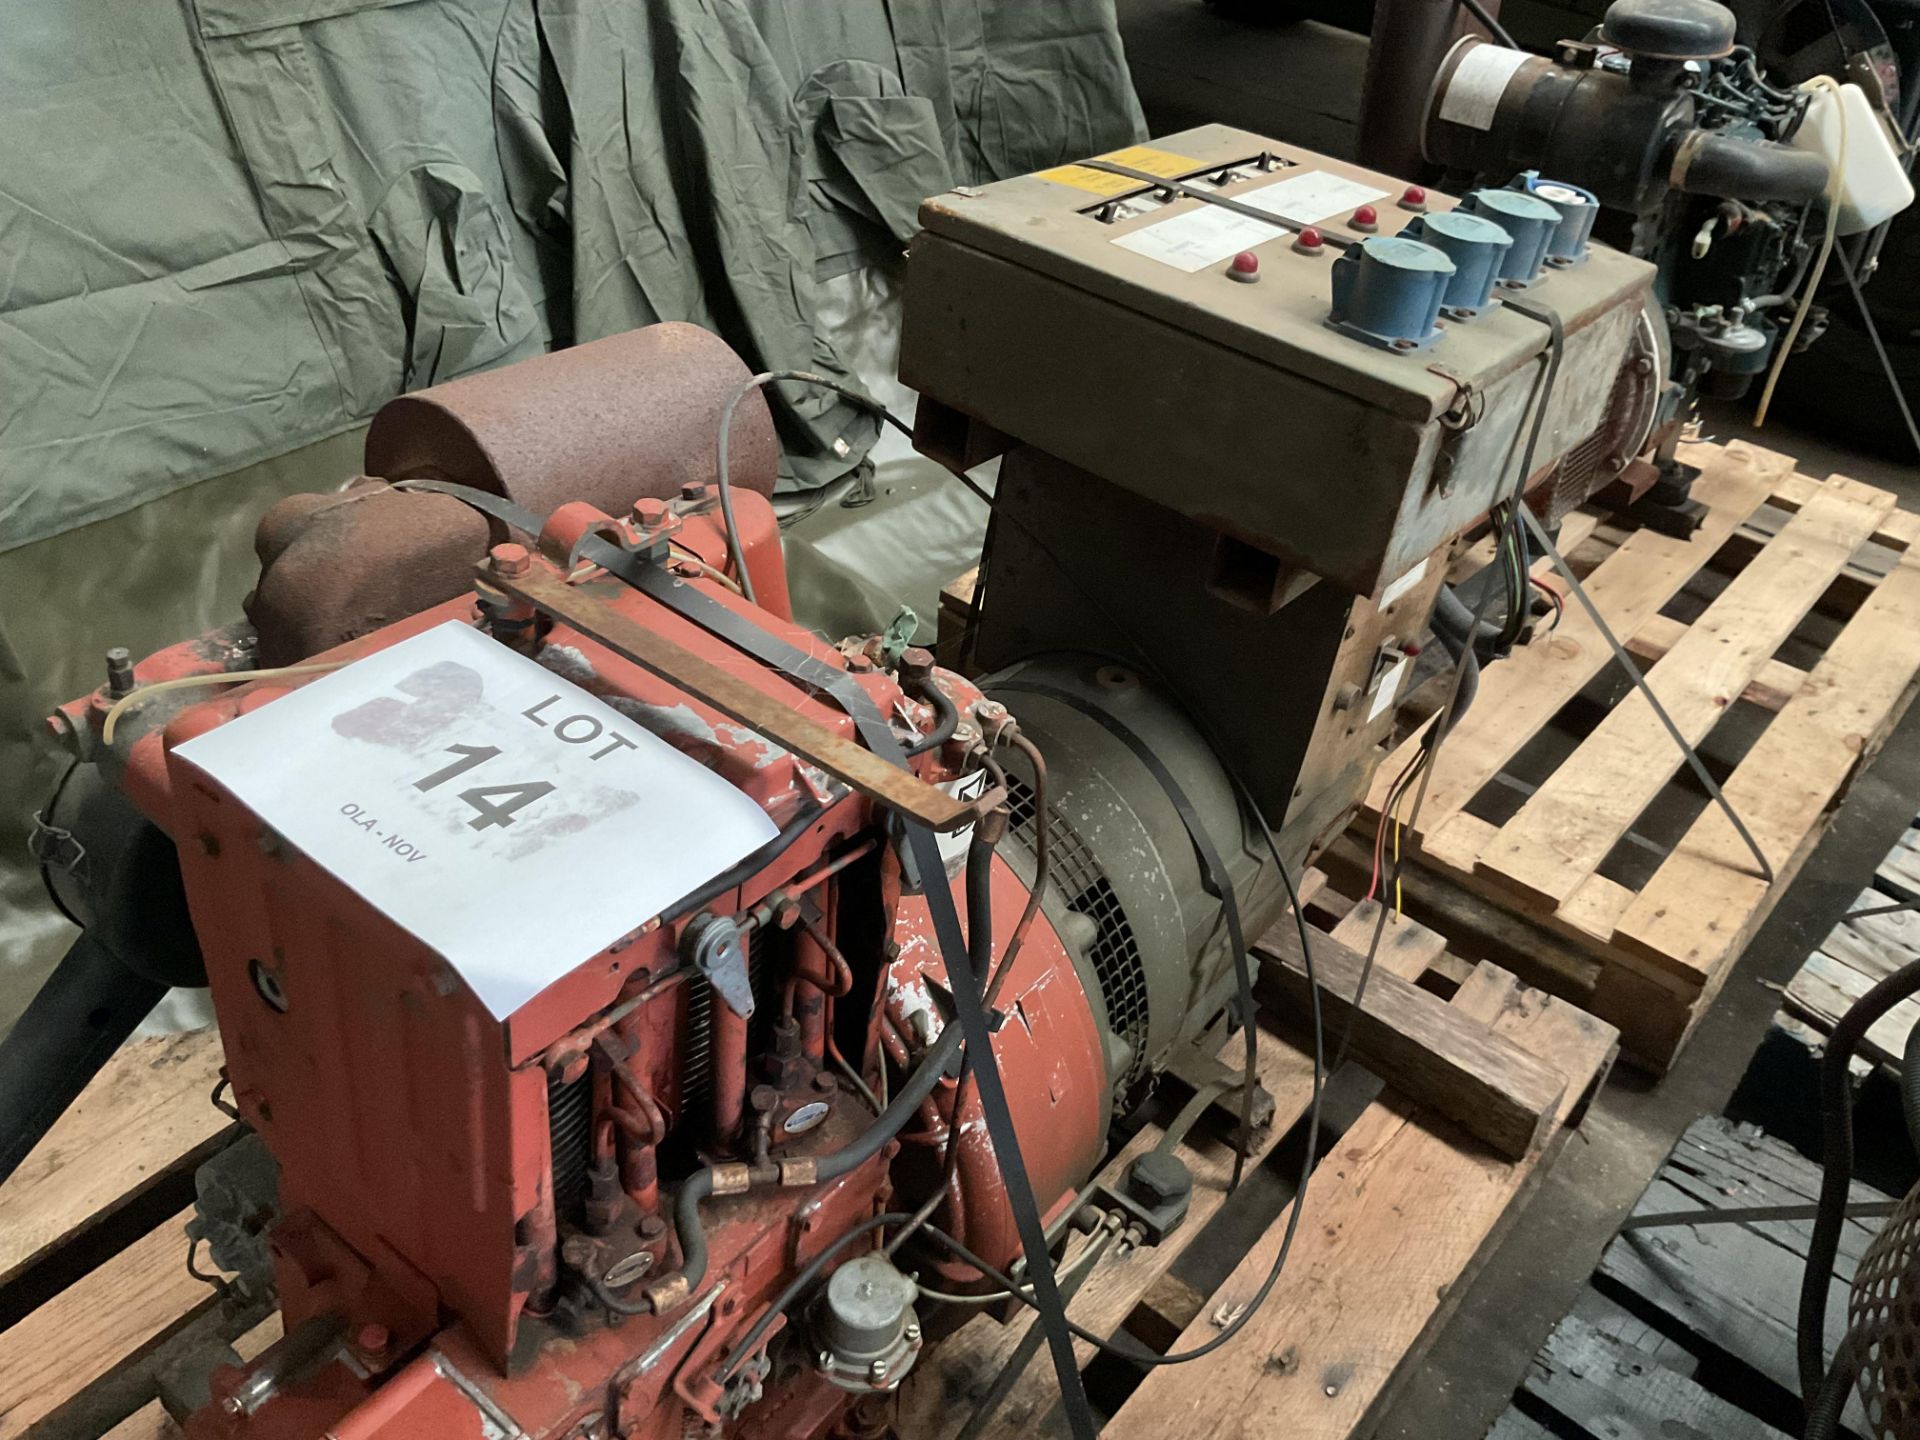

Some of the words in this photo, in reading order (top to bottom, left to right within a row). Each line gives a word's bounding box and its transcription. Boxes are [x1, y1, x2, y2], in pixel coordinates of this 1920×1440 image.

[520, 694, 639, 761] LOT
[412, 743, 557, 832] 14
[340, 803, 378, 831] OLA
[381, 834, 428, 863] NOV
